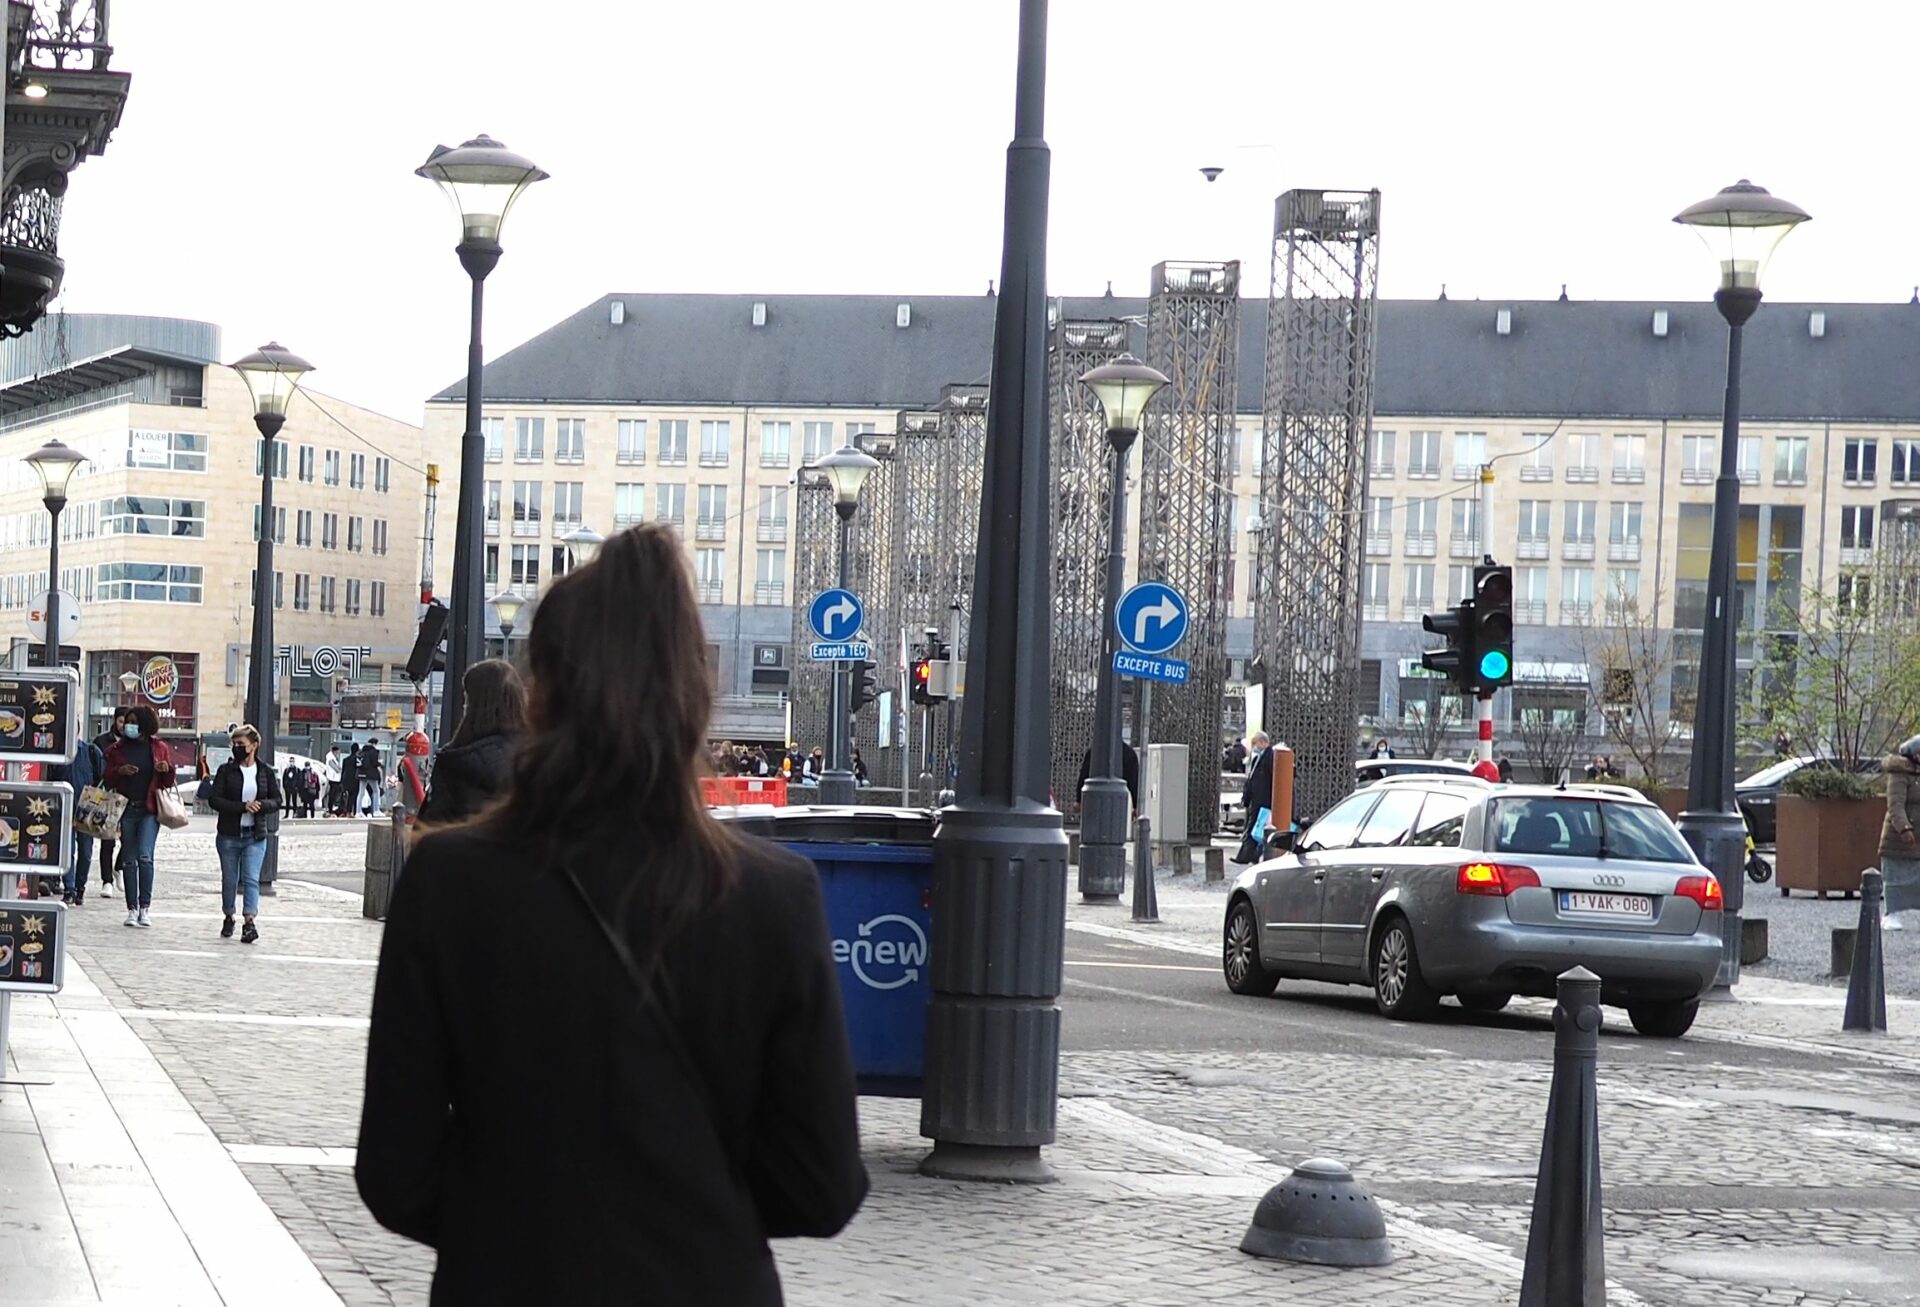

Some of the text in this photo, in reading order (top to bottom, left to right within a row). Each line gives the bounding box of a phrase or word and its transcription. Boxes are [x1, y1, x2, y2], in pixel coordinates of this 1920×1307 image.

[141, 433, 167, 441] LOUER
[848, 644, 865, 657] TEC
[145, 664, 173, 681] BURGER
[1116, 655, 1185, 679] EXCEPTE BUS
[147, 673, 175, 692] KING
[158, 708, 176, 718] 1954
